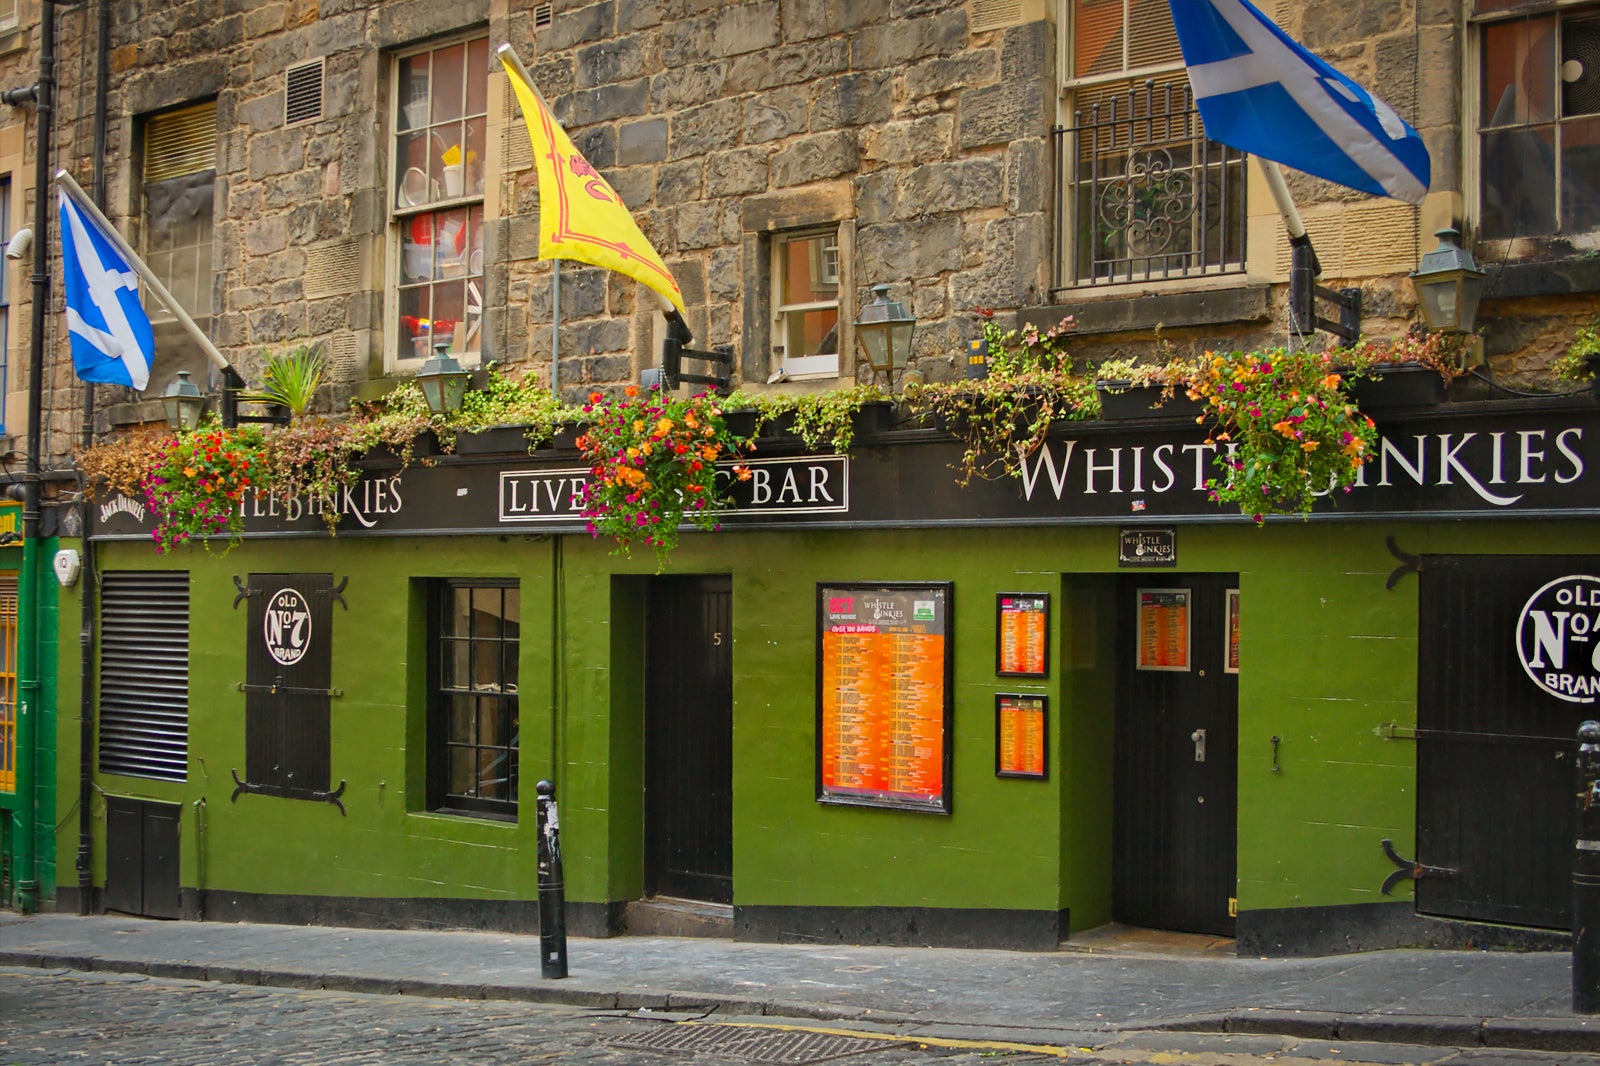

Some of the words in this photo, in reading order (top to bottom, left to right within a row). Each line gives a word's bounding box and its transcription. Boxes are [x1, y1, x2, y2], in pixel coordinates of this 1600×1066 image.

[509, 477, 588, 513] LIVE
[751, 465, 834, 505] BAR
[100, 498, 118, 522] JACK
[117, 493, 146, 523] DANIEL'S
[1124, 535, 1160, 544] WHISTLE
[278, 594, 297, 608] OLD
[1556, 585, 1600, 606] OLD
[864, 599, 894, 610] WHISTLE
[713, 632, 722, 646] 5
[274, 647, 301, 661] BRAND
[1545, 673, 1600, 695] BRAN
